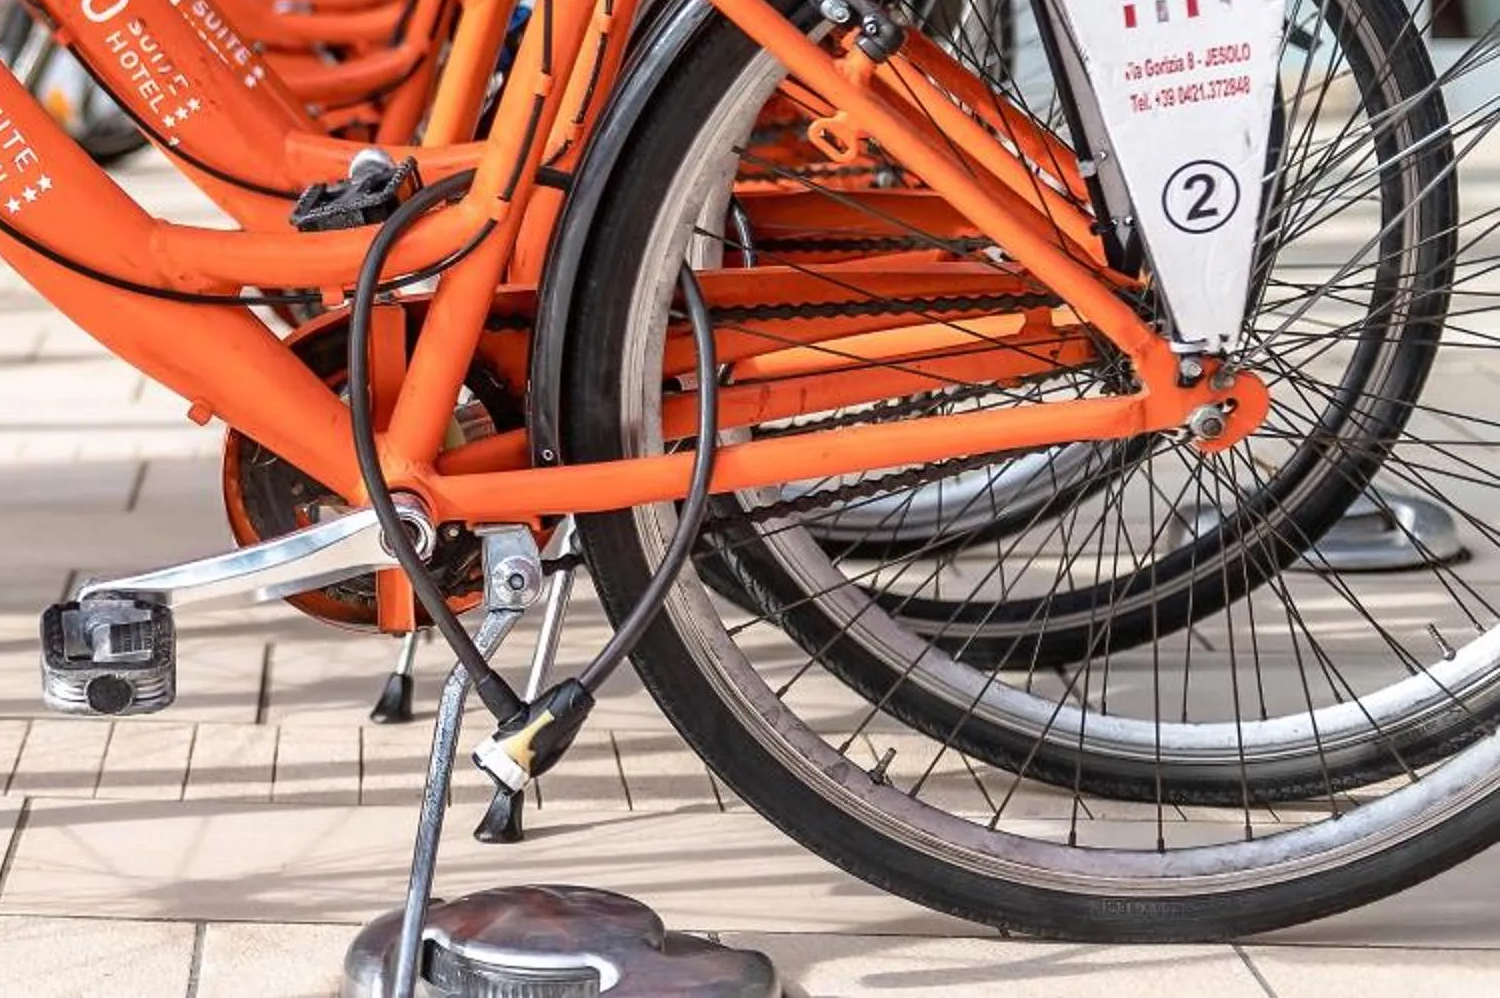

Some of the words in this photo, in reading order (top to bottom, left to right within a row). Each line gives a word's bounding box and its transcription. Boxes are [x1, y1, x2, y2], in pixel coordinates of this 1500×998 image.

[104, 29, 165, 115] HOTEL
[1204, 42, 1252, 68] JESOLO
[1182, 172, 1221, 222] 2
